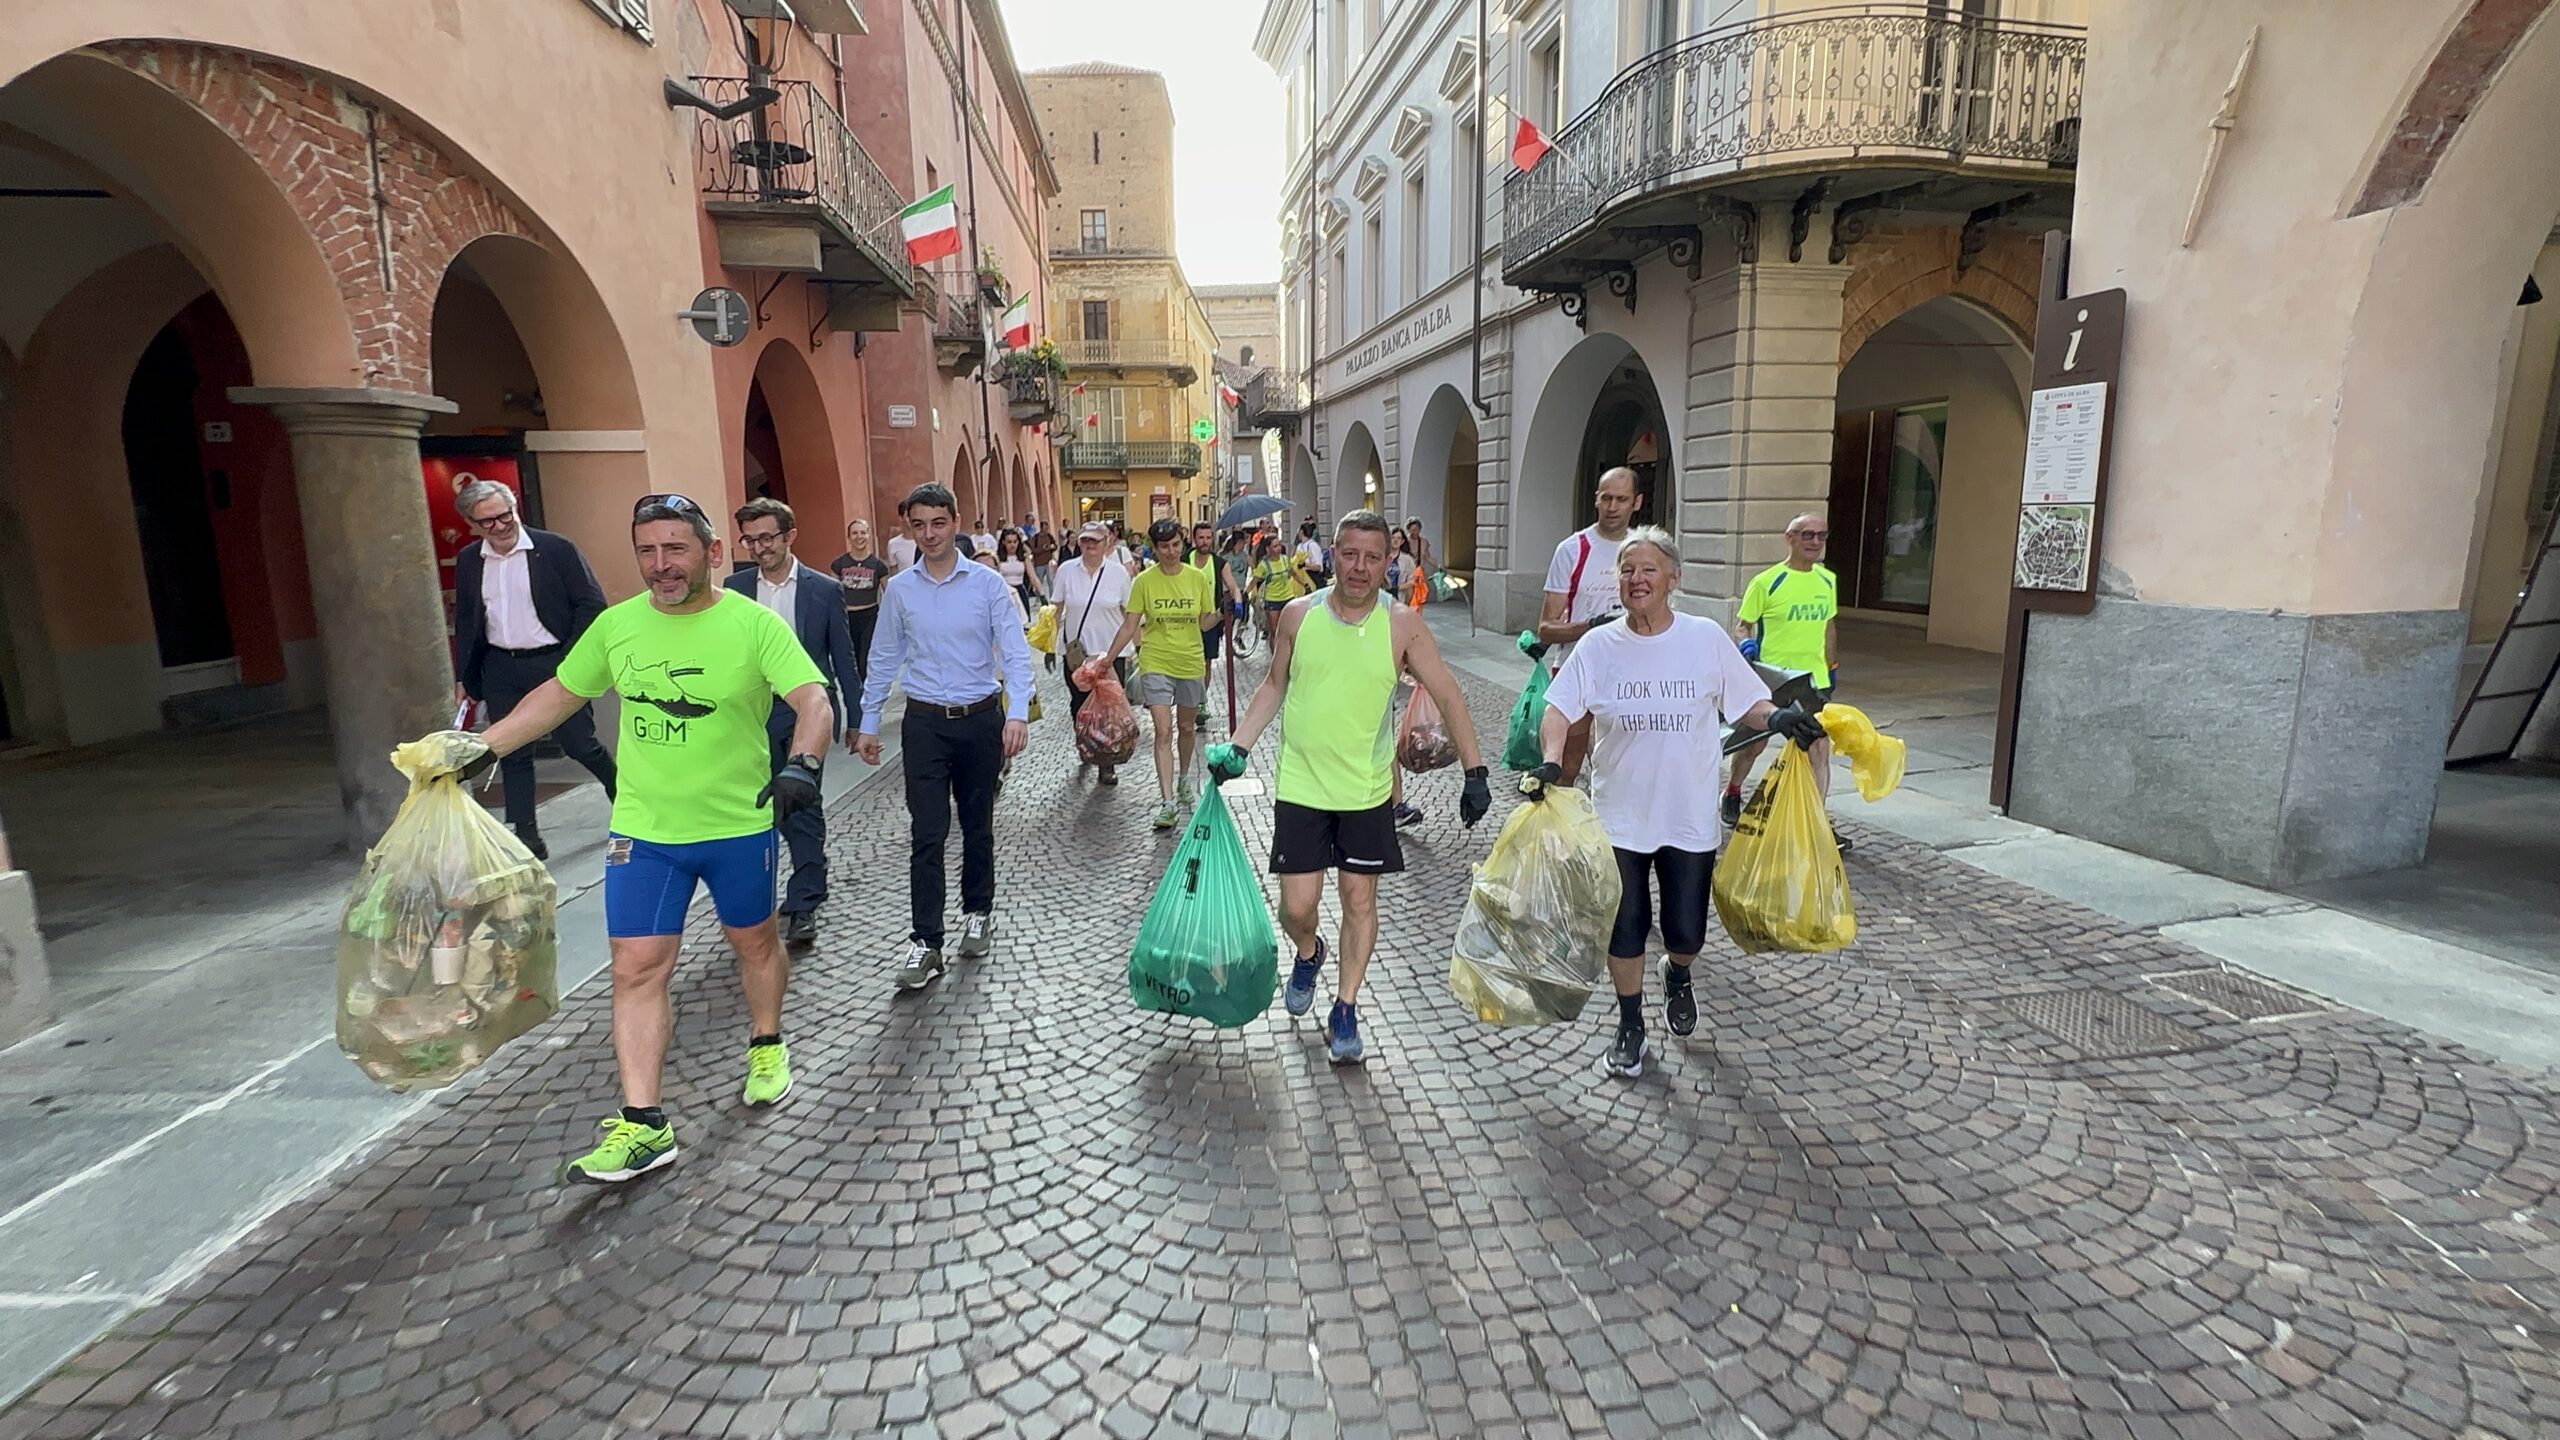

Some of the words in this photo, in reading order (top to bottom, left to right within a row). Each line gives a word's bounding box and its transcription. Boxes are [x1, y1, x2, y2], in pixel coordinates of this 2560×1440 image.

[1345, 344, 1379, 377] PALAZZO
[1381, 330, 1411, 359] BANCA
[1413, 303, 1452, 342] D'ALBA
[1154, 598, 1195, 609] STAFF
[1617, 680, 1652, 700] LOOK
[1659, 680, 1696, 699] WITH
[1619, 714, 1646, 732] THE
[1649, 713, 1693, 732] HEART
